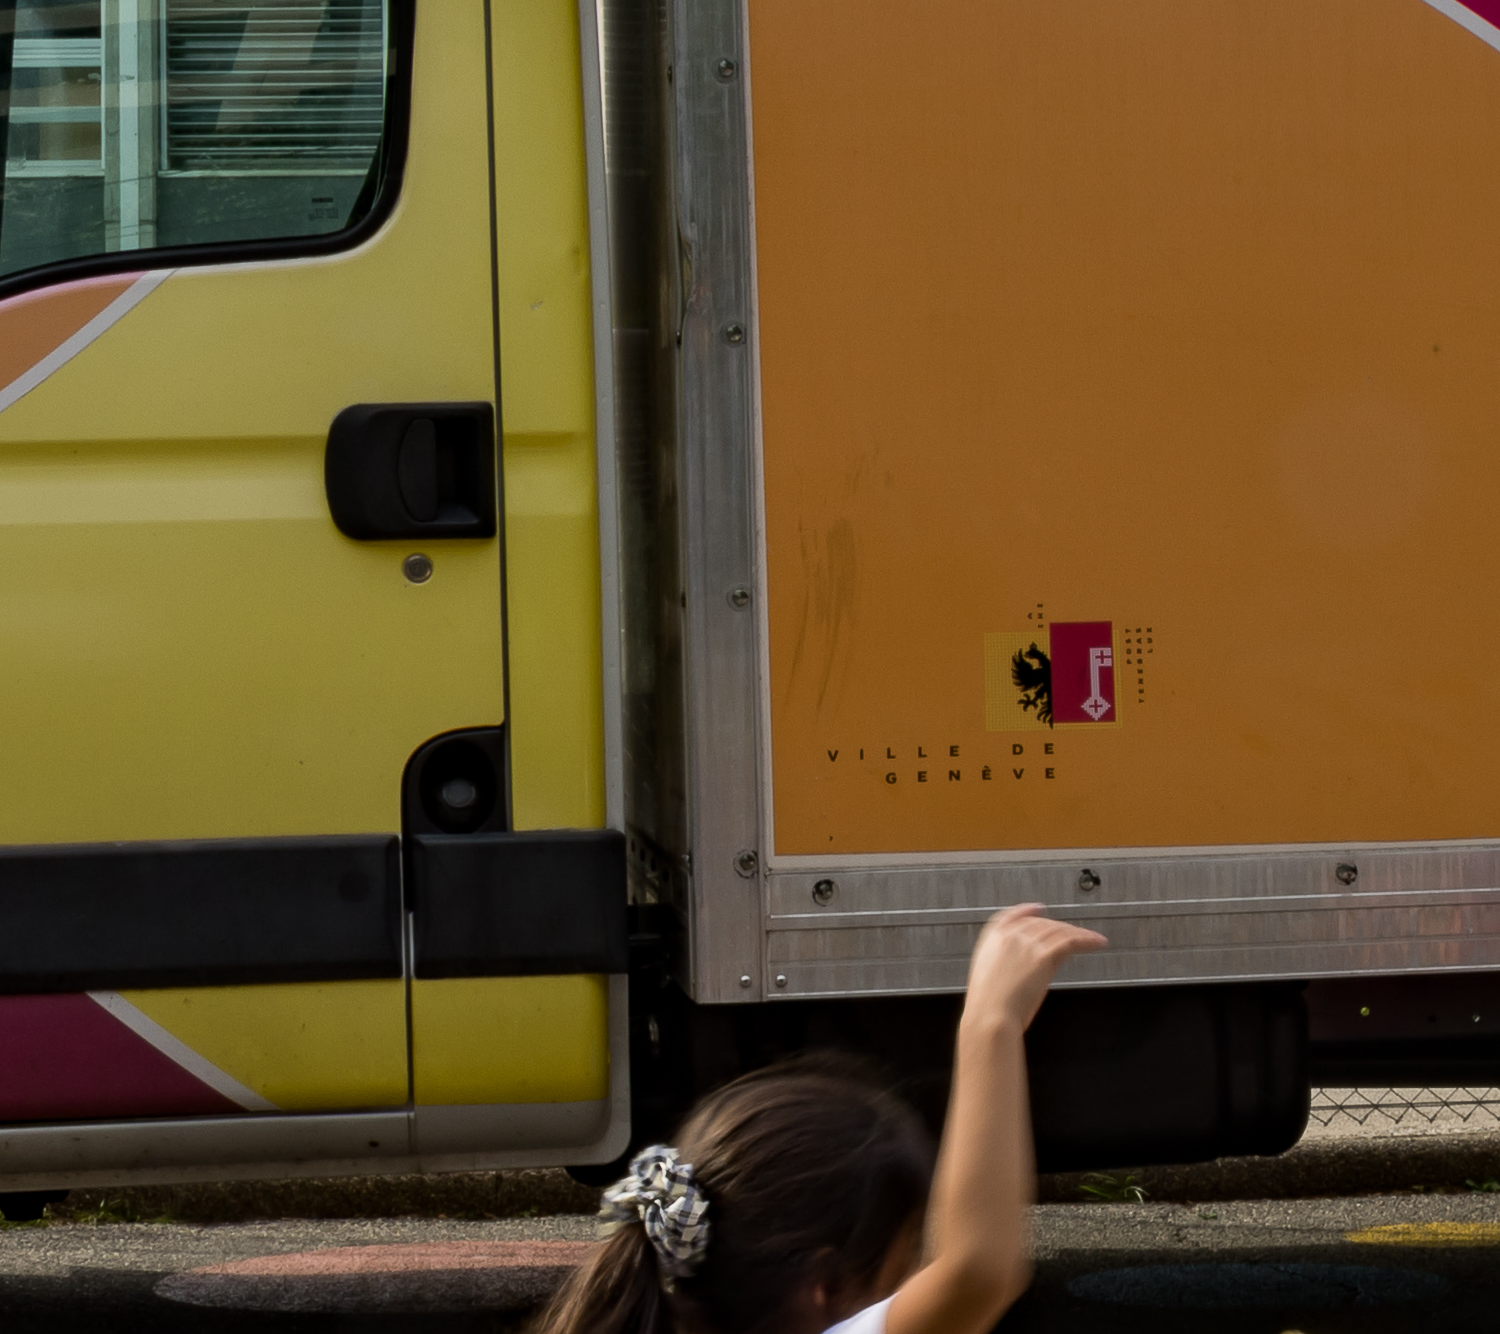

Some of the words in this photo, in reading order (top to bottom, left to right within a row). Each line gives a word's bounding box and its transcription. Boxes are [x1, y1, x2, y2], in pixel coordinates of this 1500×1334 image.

[826, 743, 961, 763] VILLE
[1011, 742, 1056, 757] DE
[884, 764, 1057, 785] GENÈVE
